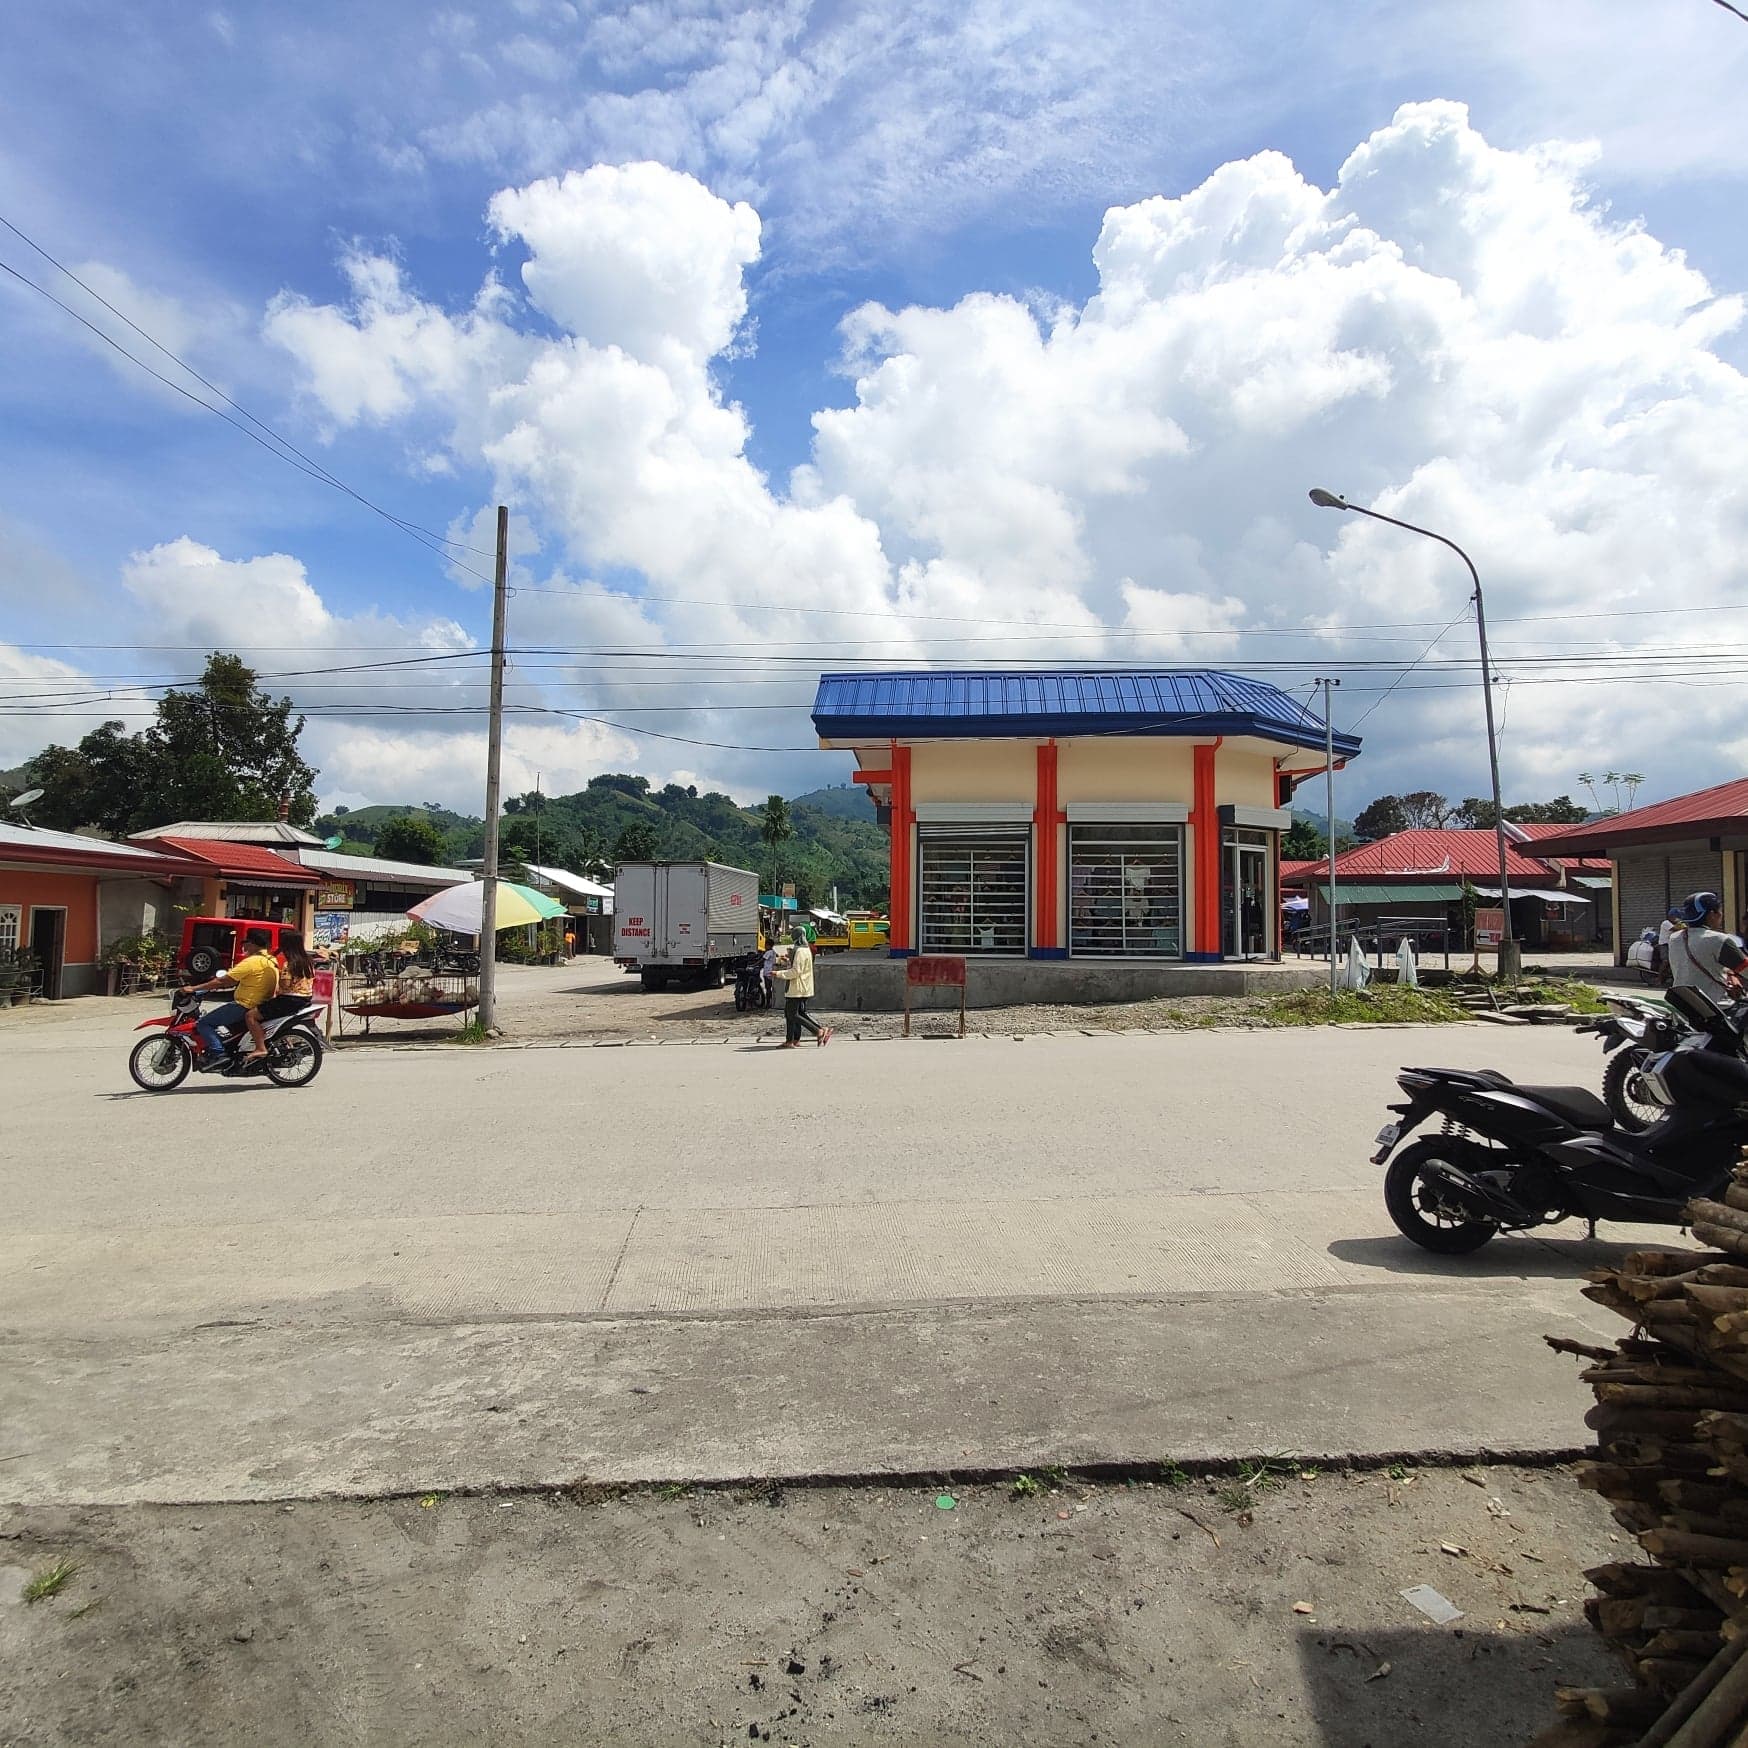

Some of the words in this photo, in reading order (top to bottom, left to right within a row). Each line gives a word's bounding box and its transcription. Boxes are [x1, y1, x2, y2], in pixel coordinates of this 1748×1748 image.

[327, 894, 346, 903] STORE
[628, 918, 643, 926] KEEP
[621, 928, 651, 937] DISTANCE
